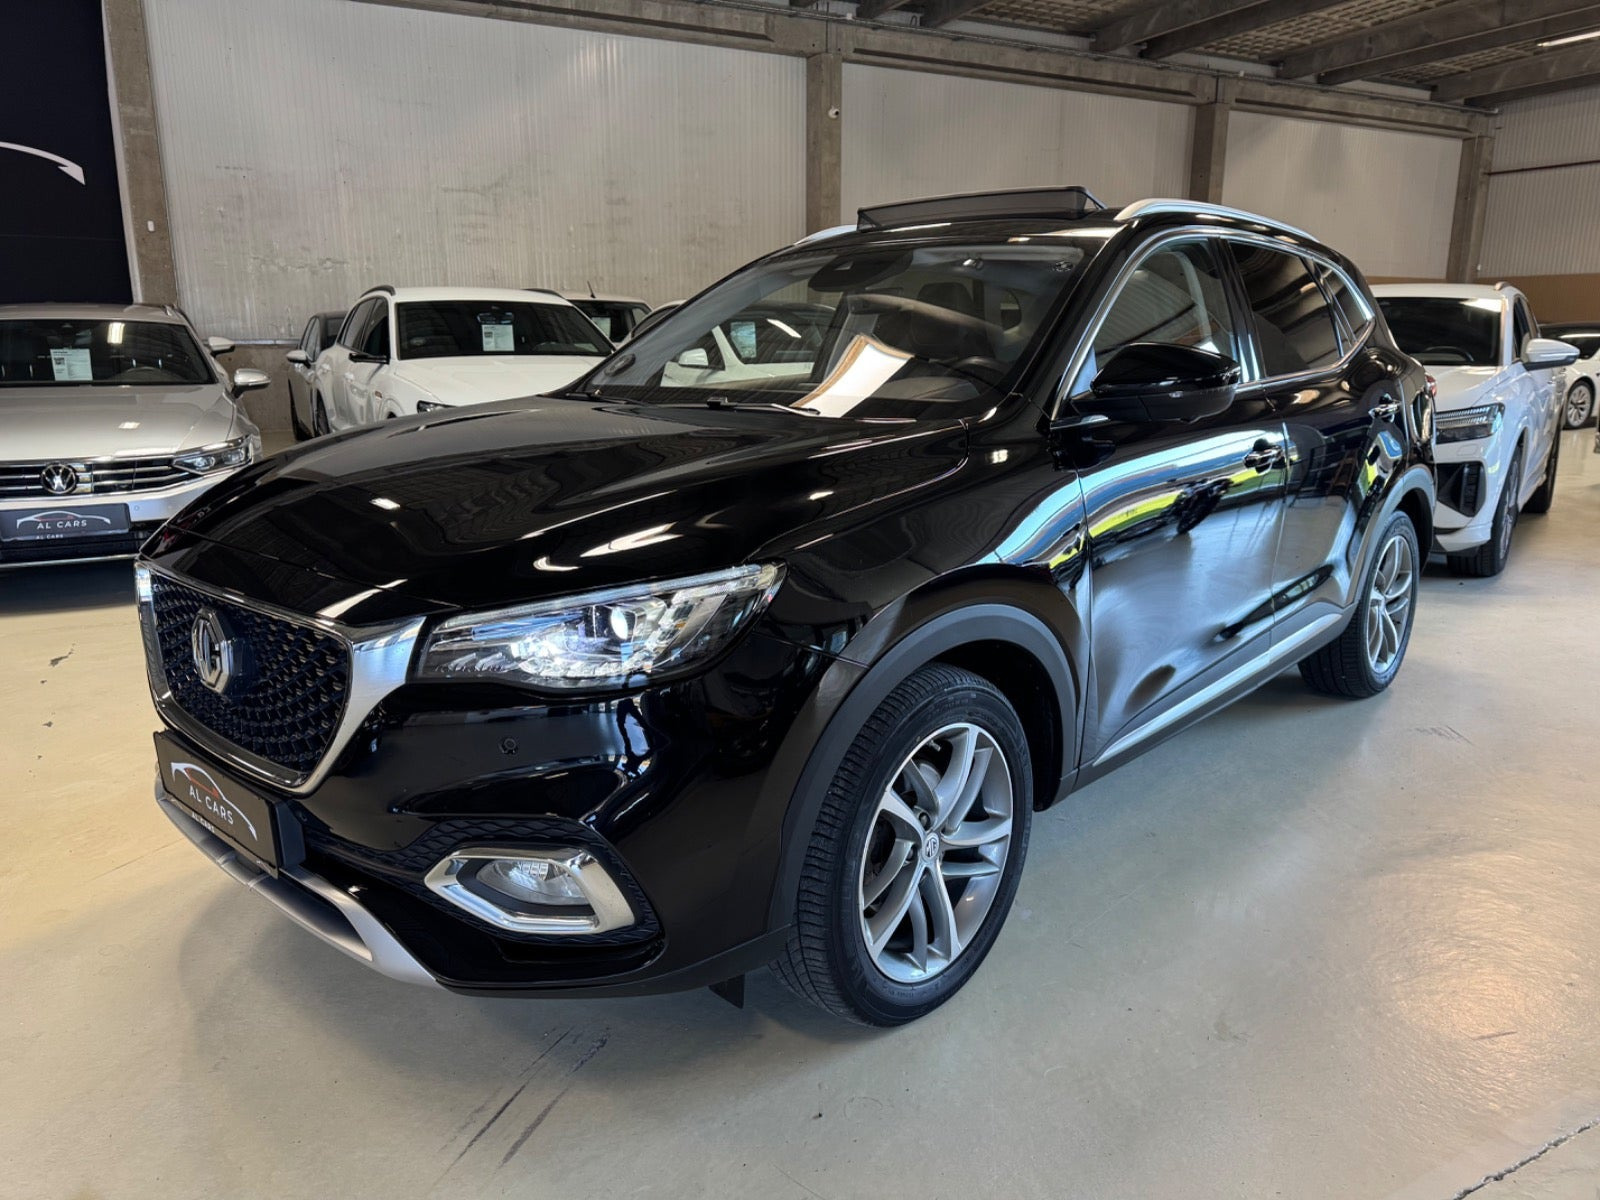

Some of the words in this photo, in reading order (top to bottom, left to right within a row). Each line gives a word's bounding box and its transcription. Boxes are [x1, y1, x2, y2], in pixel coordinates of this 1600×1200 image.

[57, 520, 87, 528] CARS
[189, 784, 202, 803] AL
[205, 796, 234, 825] CARS
